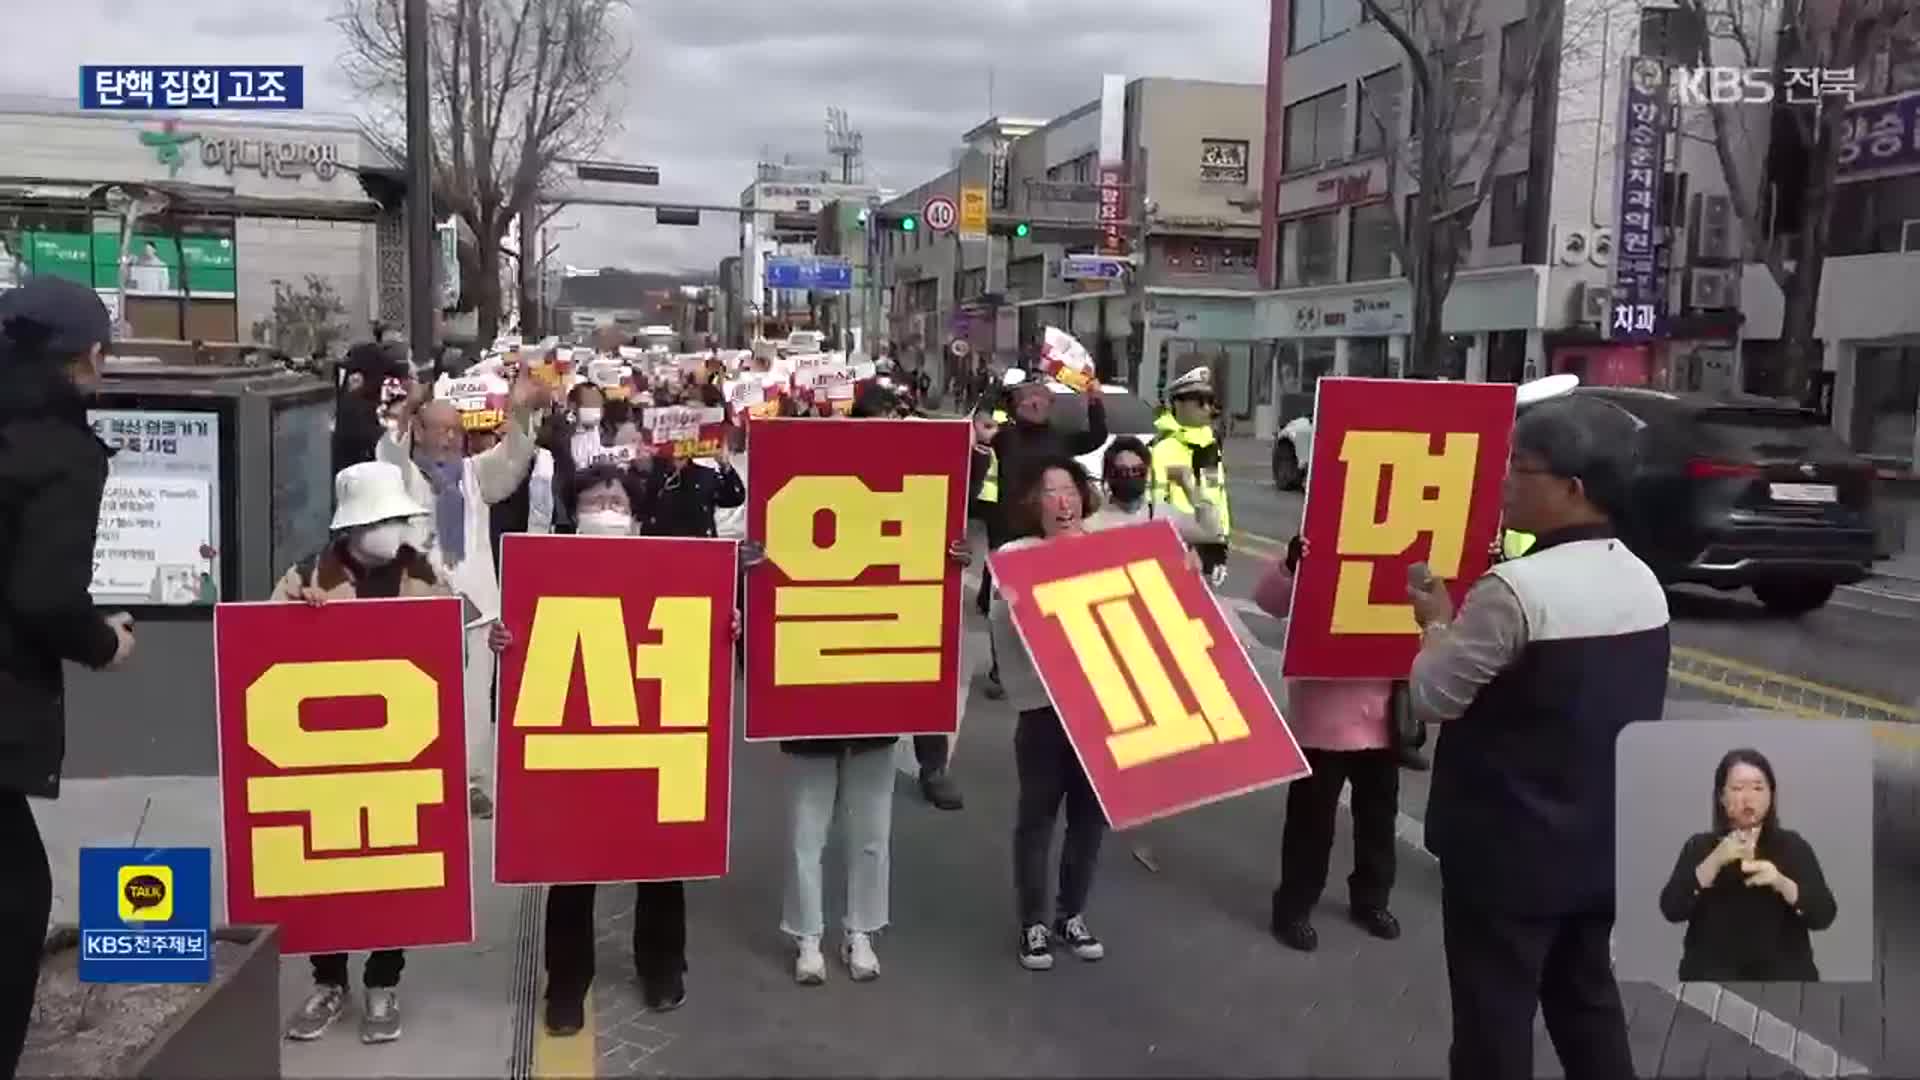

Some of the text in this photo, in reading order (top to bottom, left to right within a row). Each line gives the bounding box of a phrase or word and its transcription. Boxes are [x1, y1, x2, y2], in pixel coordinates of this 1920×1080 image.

[202, 138, 338, 180] 하나은행
[930, 205, 951, 223] 40
[1613, 303, 1657, 335] 치과
[766, 475, 948, 685] 열
[1330, 430, 1480, 635] 면
[515, 597, 712, 823] 석
[1038, 561, 1250, 767] 파
[247, 660, 444, 898] 윤
